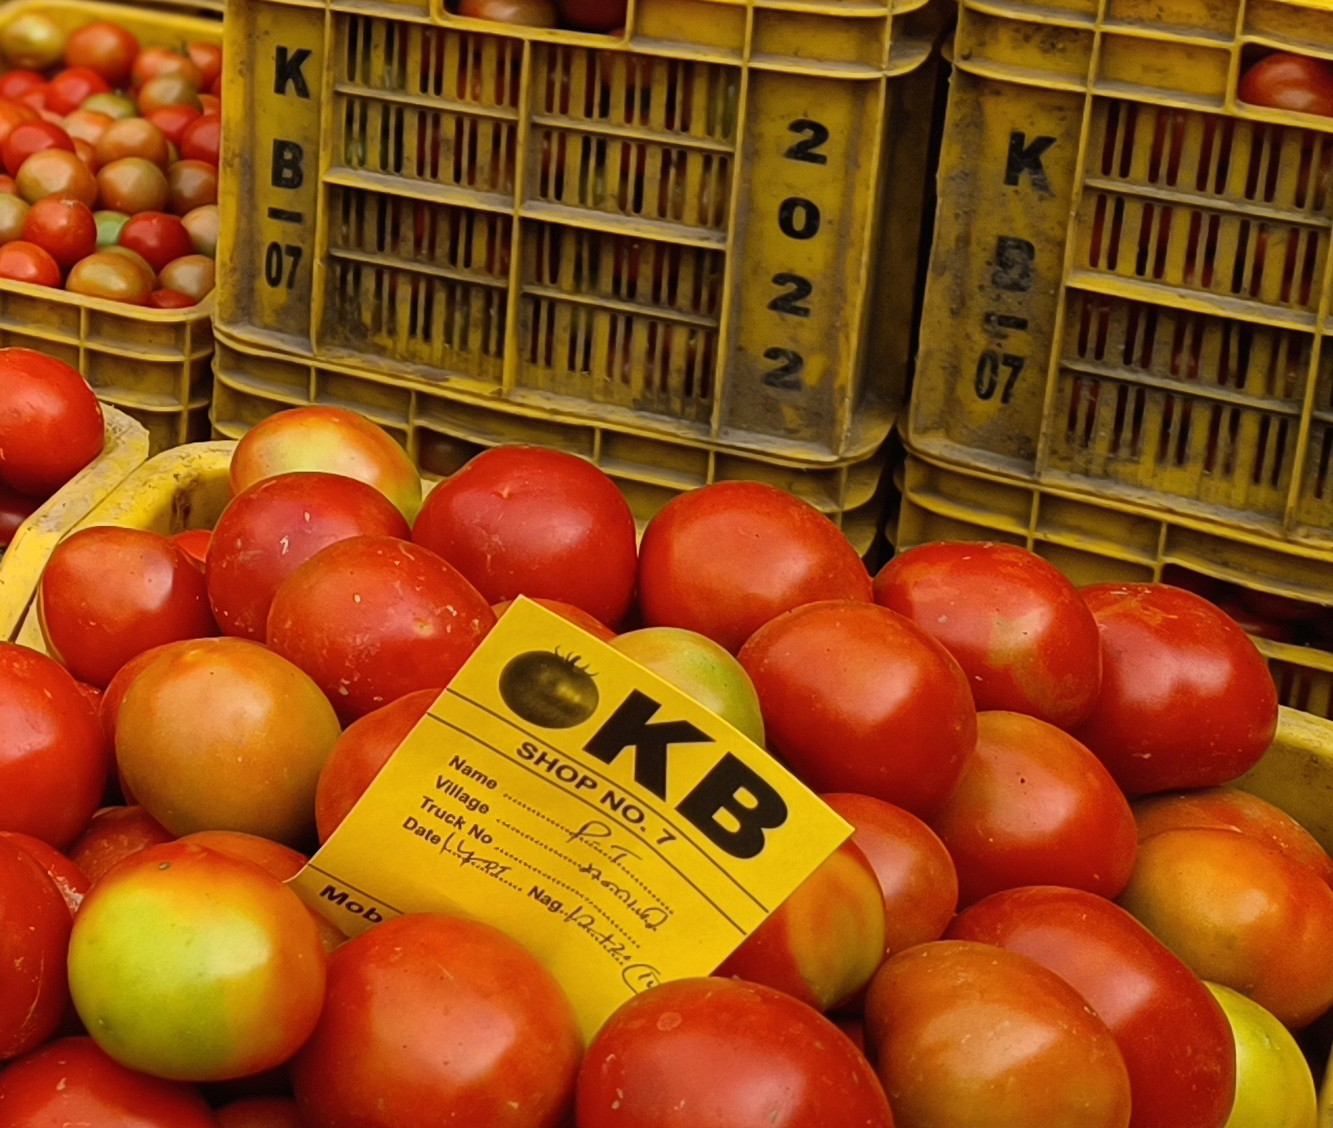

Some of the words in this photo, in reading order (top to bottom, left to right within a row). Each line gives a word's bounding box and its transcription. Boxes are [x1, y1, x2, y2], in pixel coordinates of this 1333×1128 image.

[762, 120, 829, 391] 2022
[435, 774, 490, 815] Village
[448, 755, 498, 790] Name
[516, 741, 598, 791] SHOP
[599, 790, 646, 833] NO.
[655, 827, 678, 846] 7
[582, 688, 788, 859] KB
[402, 815, 442, 846] Date
[420, 795, 467, 830] Truck
[467, 823, 493, 845] No
[319, 884, 384, 923] Mob
